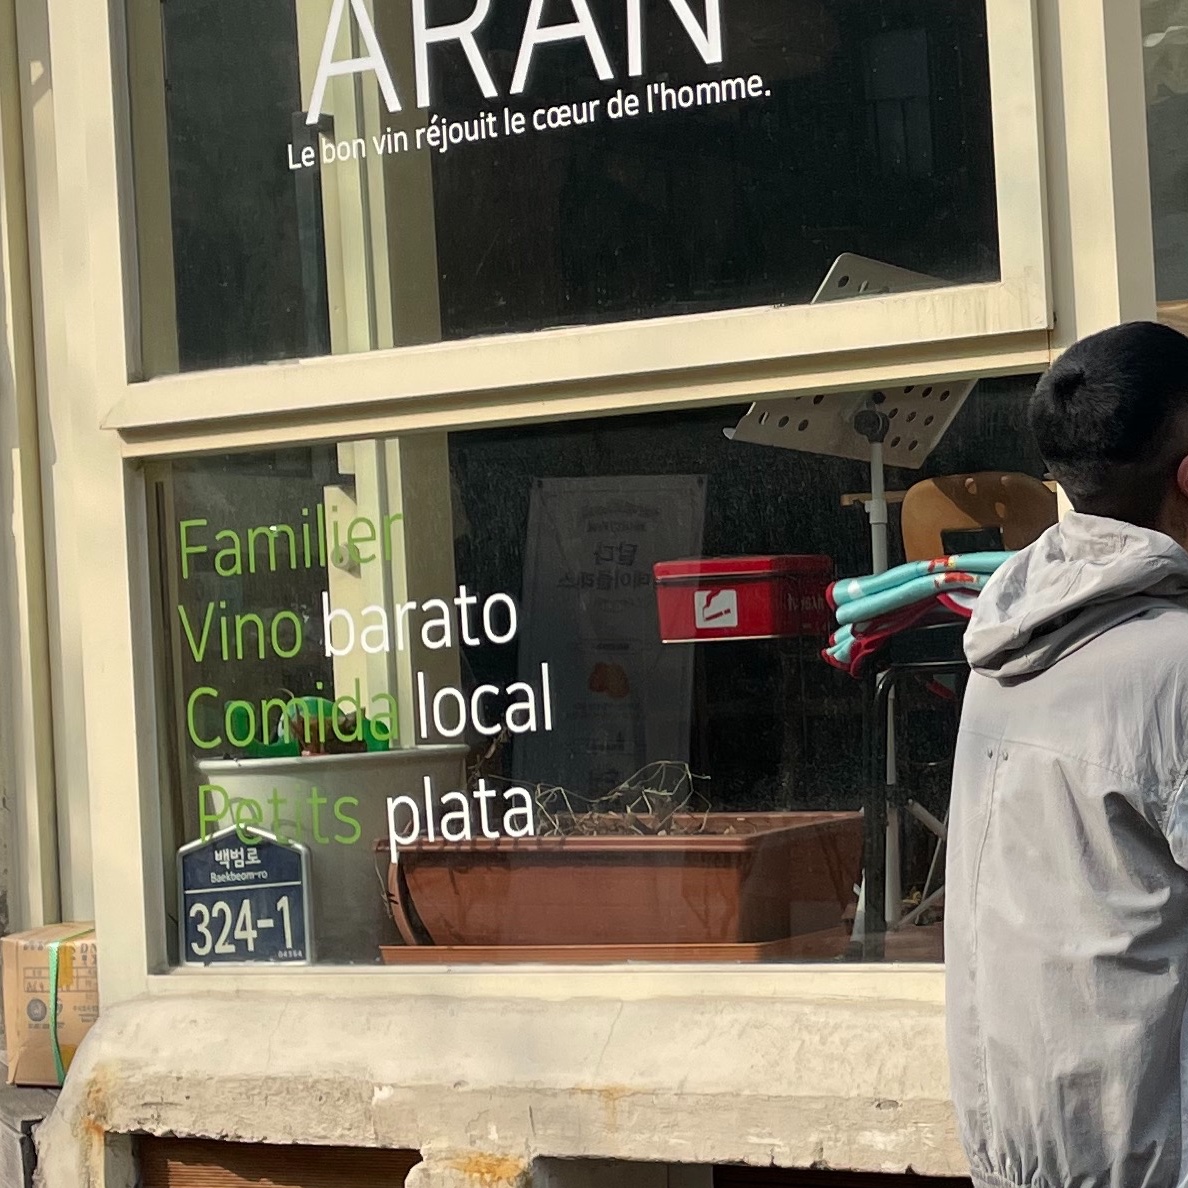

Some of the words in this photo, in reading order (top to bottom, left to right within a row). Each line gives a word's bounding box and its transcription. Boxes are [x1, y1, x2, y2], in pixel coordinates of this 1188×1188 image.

[287, 142, 315, 170] Le
[321, 132, 367, 166] bon
[372, 127, 408, 156] vin
[416, 110, 499, 154] réjouit
[504, 108, 526, 136] le
[532, 98, 600, 130] cœur
[608, 89, 640, 121] de
[646, 72, 772, 114] l'homme.
[179, 503, 405, 579] Familier
[177, 600, 303, 663] Vino
[321, 583, 518, 658] barato
[187, 677, 399, 749] Comida
[417, 662, 554, 739] local
[198, 778, 362, 846] Petits
[385, 775, 536, 863] plata
[214, 847, 261, 869] 백범로
[210, 870, 268, 884] Baekbeom-ro
[189, 895, 293, 956] 324-1
